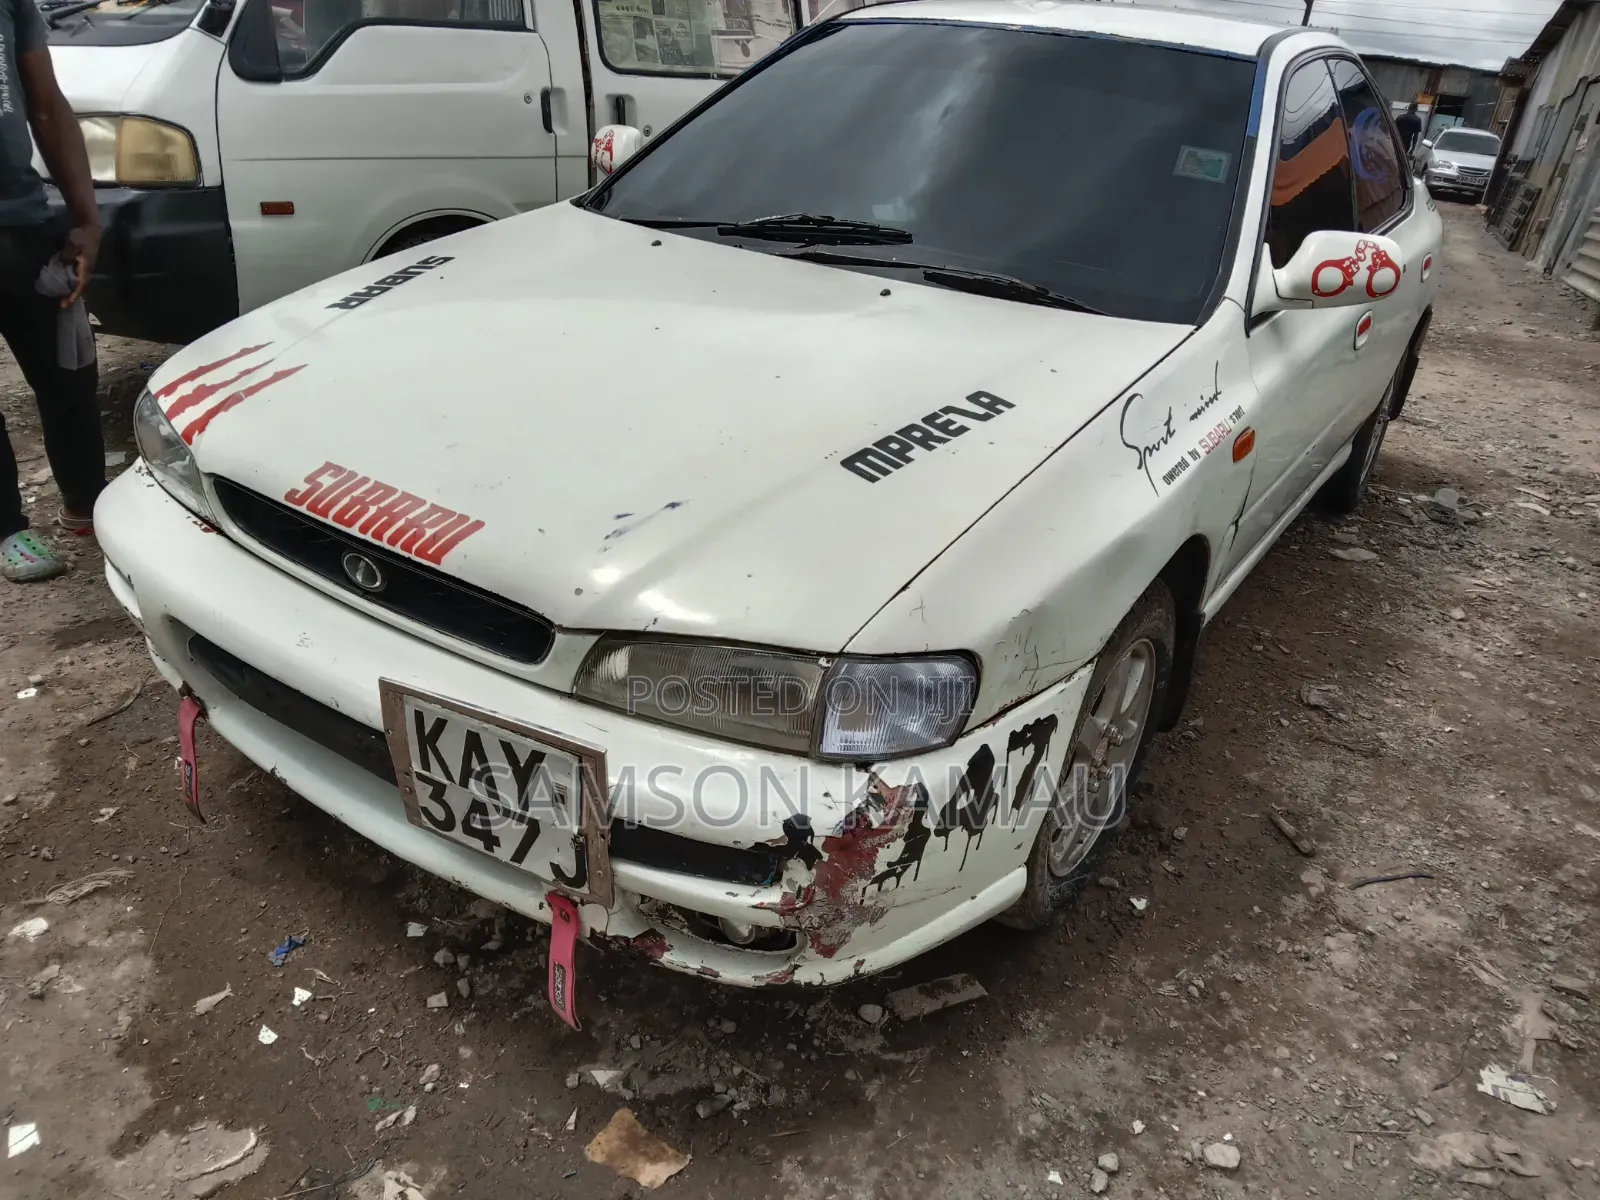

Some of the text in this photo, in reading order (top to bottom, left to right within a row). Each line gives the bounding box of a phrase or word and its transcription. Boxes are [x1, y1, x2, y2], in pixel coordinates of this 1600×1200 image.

[1162, 455, 1190, 486] owered
[1187, 447, 1202, 462] by
[1198, 418, 1233, 456] SUBARU
[284, 460, 486, 567] SUBARU
[413, 708, 548, 813] KAY
